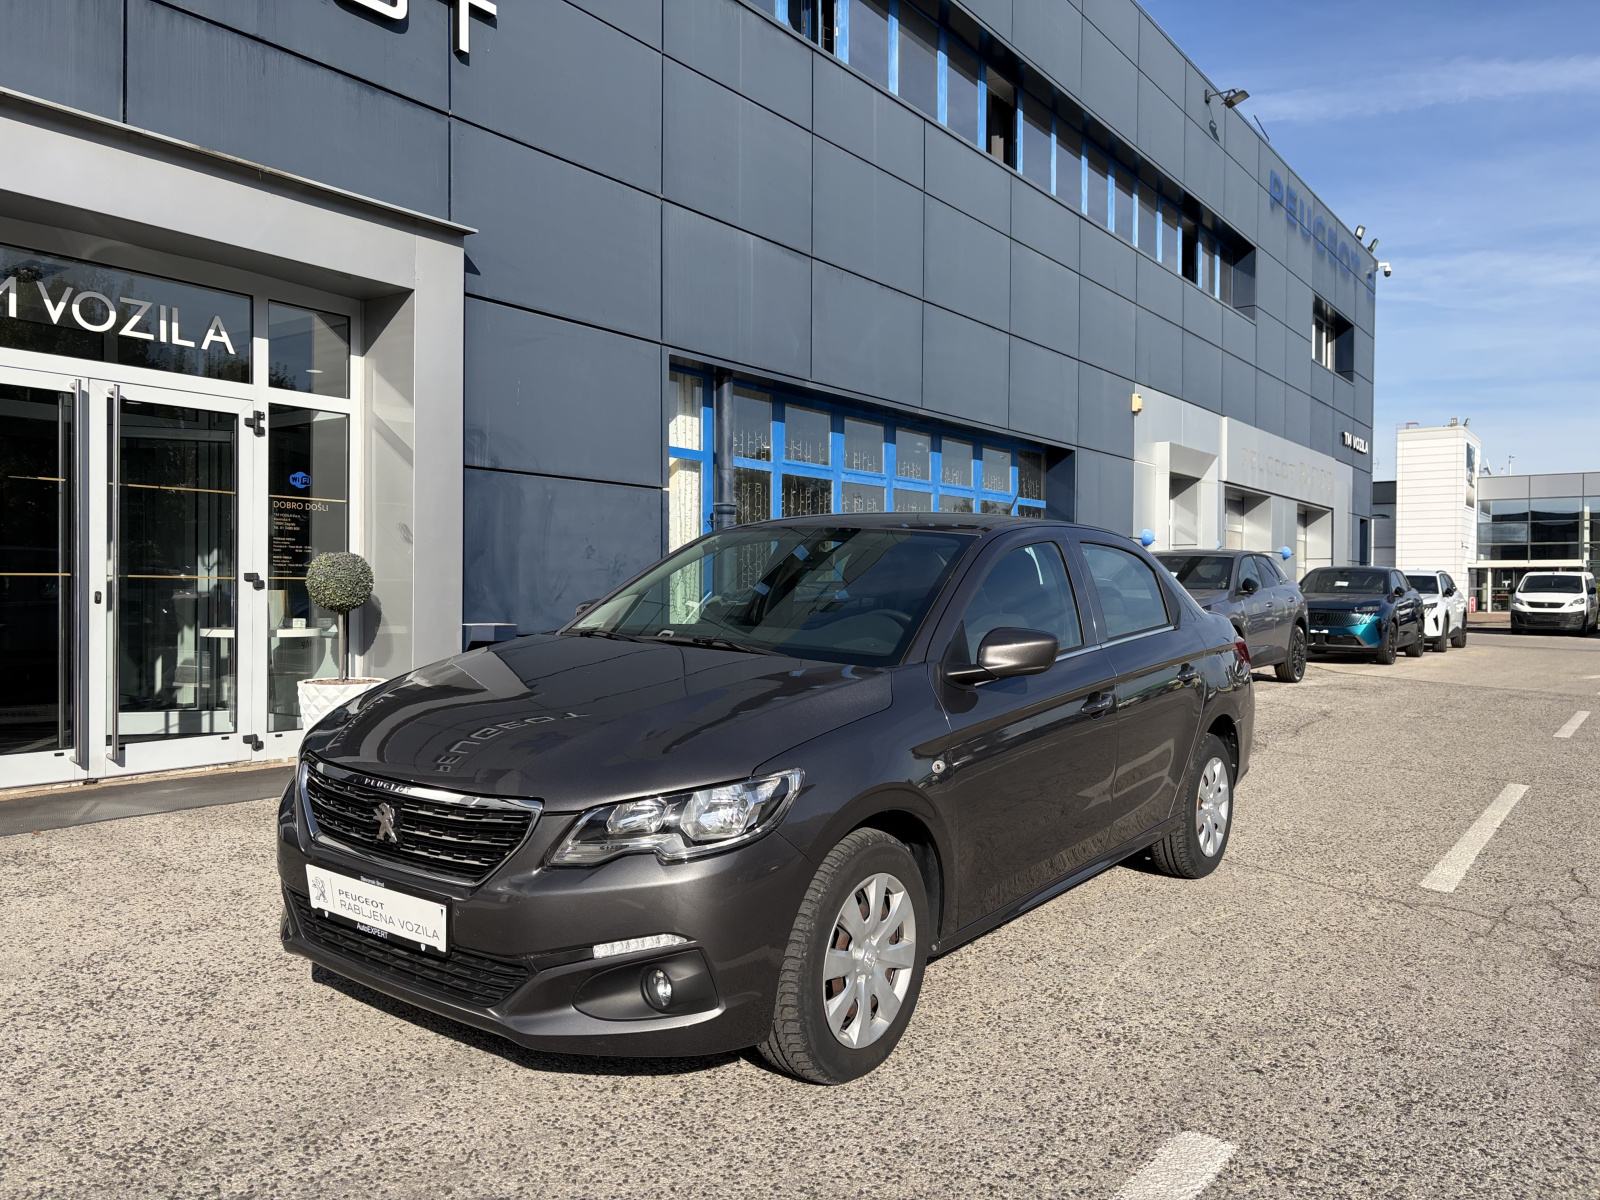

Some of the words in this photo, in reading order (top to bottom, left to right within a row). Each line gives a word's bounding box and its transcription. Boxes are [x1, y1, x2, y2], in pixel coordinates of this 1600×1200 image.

[37, 281, 235, 354] VOZILA
[1344, 431, 1352, 447] TM
[1353, 434, 1369, 455] VOZILA
[273, 500, 303, 510] DOBRO
[305, 502, 329, 512] DOŠLI
[338, 888, 385, 910] PEUGEOT
[340, 899, 395, 927] RABLJENA
[398, 918, 440, 941] VOZILA
[356, 921, 388, 939] AutoEXPERT
